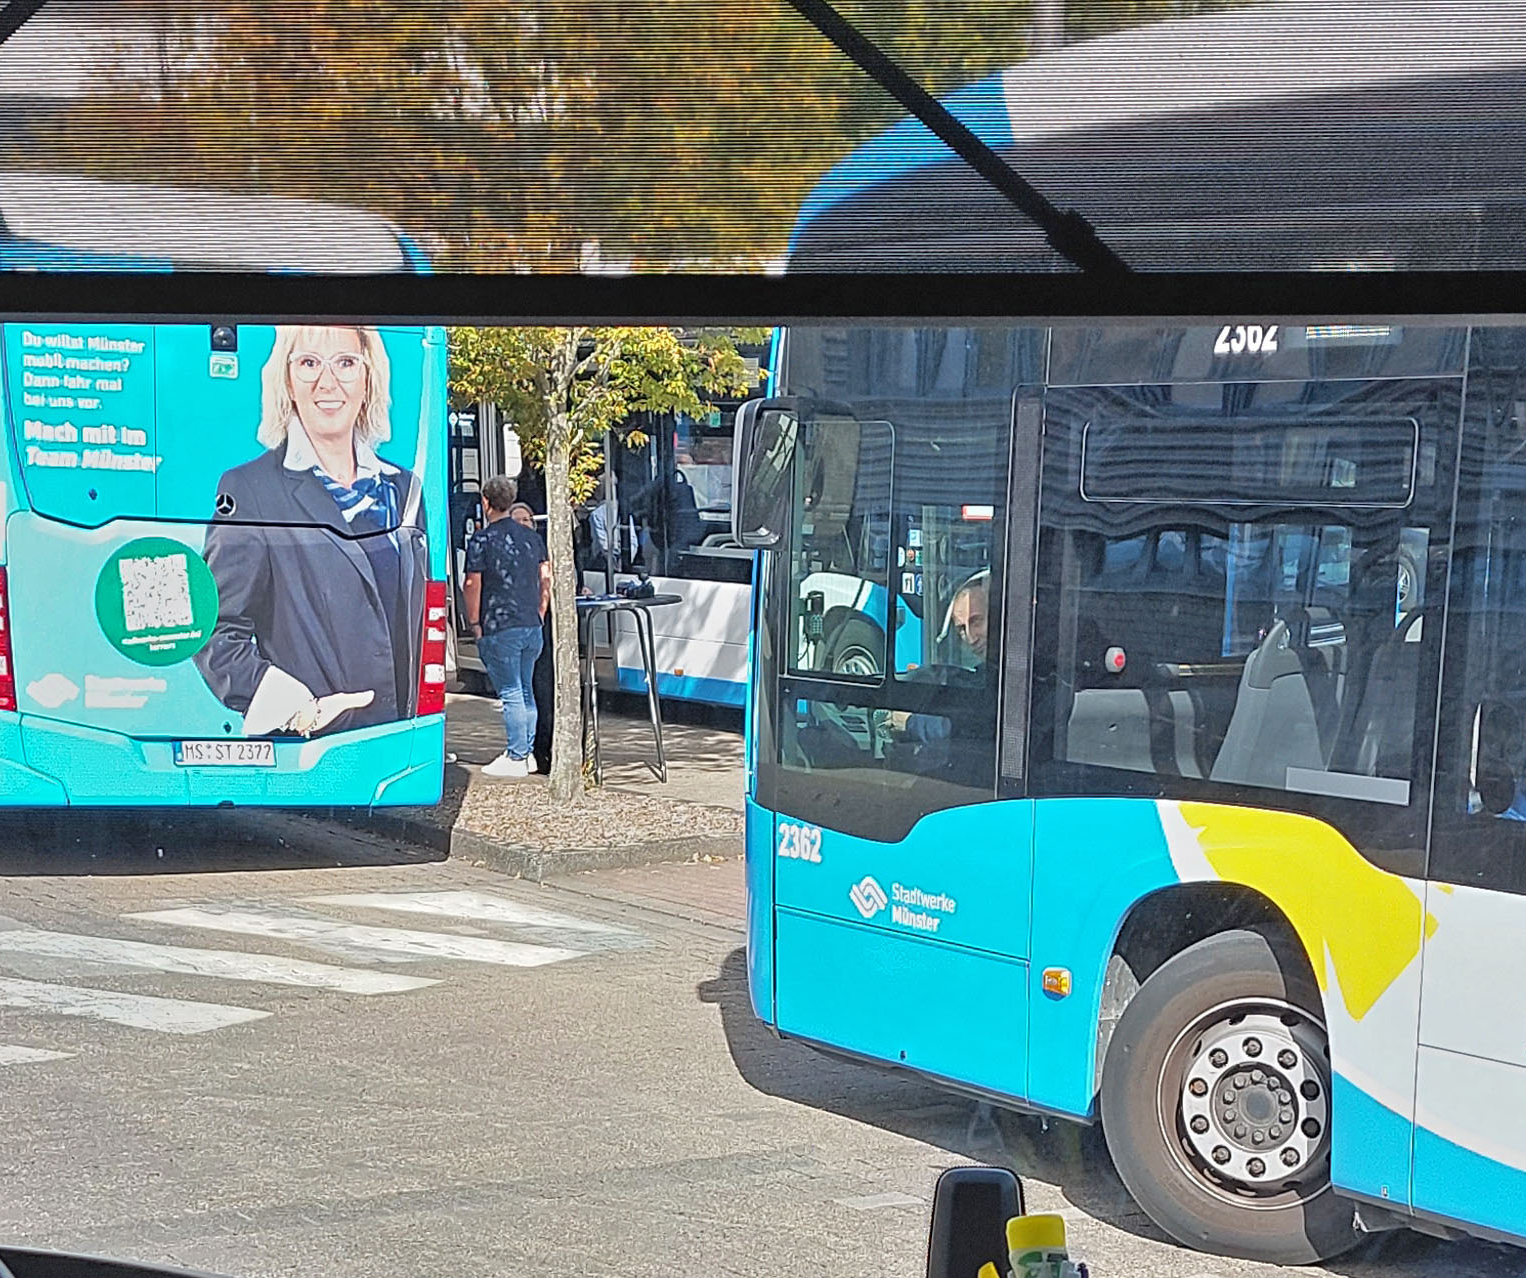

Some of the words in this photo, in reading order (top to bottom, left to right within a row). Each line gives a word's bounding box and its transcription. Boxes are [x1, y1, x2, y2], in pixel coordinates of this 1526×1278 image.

[23, 331, 42, 347] Du
[45, 333, 83, 349] willst
[87, 336, 145, 353] Münster
[24, 353, 64, 368] mobil
[65, 356, 130, 372] machen?
[24, 372, 60, 387] Dann
[64, 375, 92, 390] fahr
[96, 378, 122, 391] mal
[24, 392, 45, 406] bei
[49, 396, 74, 408] uns
[24, 420, 78, 442] Mach
[82, 424, 116, 444] mit
[121, 427, 147, 446] im
[26, 446, 78, 468] Team
[81, 448, 163, 471] Münster
[215, 743, 232, 760] ST
[237, 744, 272, 760] 2377
[778, 823, 822, 863] 2362
[892, 883, 956, 913] Stadtwerke
[892, 904, 940, 932] Münster
